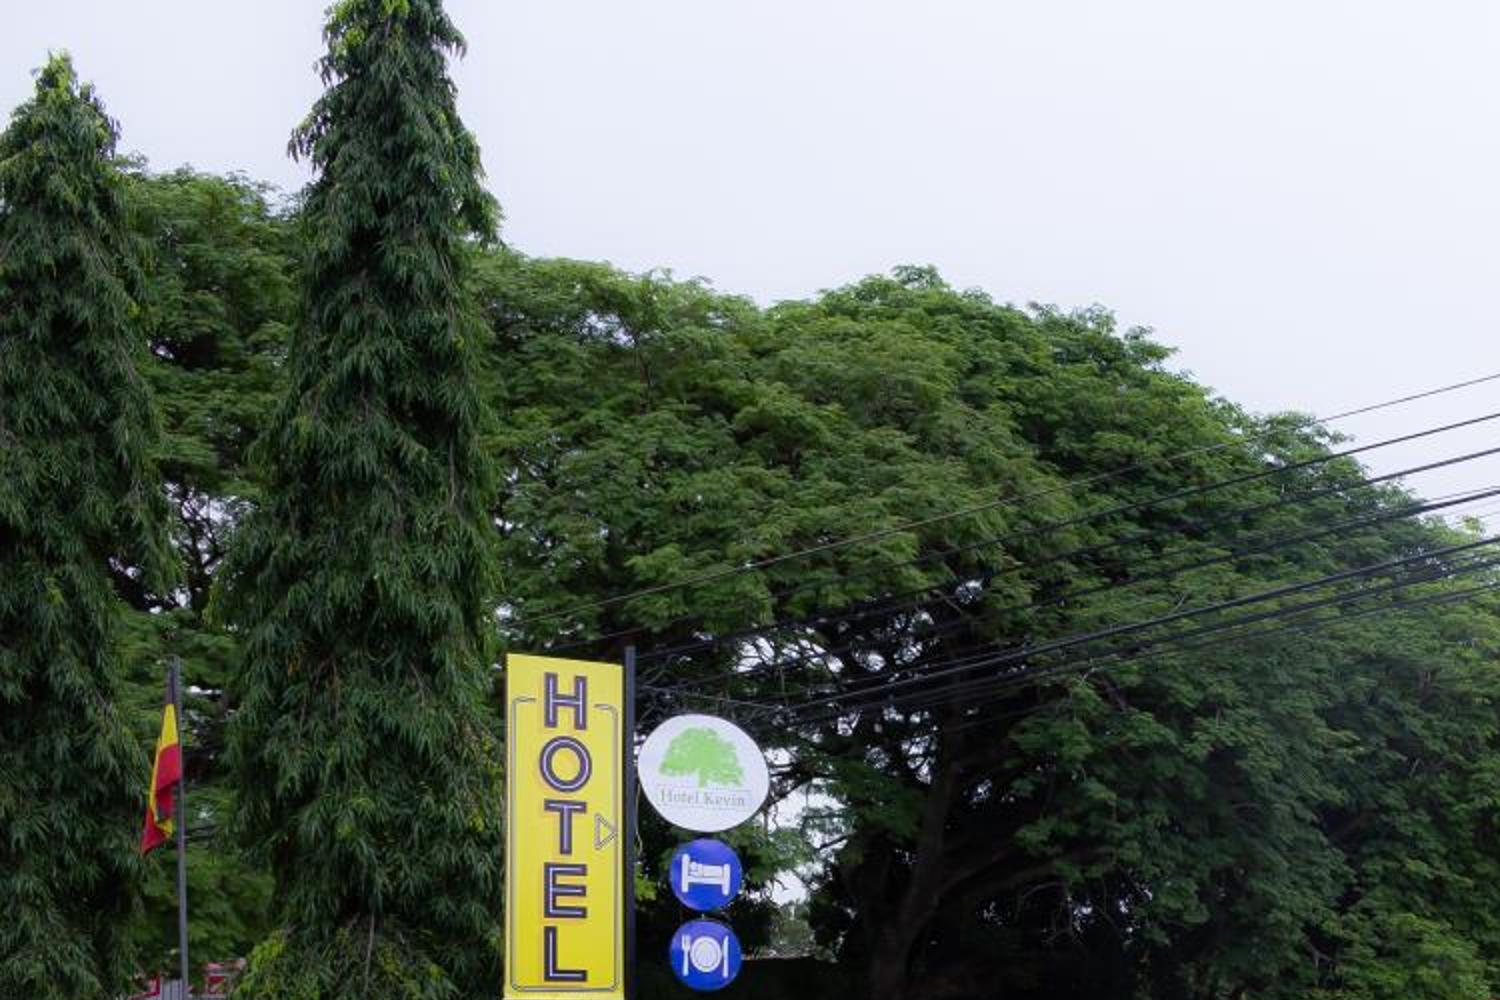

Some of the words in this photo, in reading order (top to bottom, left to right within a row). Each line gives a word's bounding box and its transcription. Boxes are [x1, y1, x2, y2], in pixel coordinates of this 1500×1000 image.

[539, 671, 593, 983] HOTEL
[660, 787, 699, 804] Hotel
[703, 791, 745, 807] Kevin
